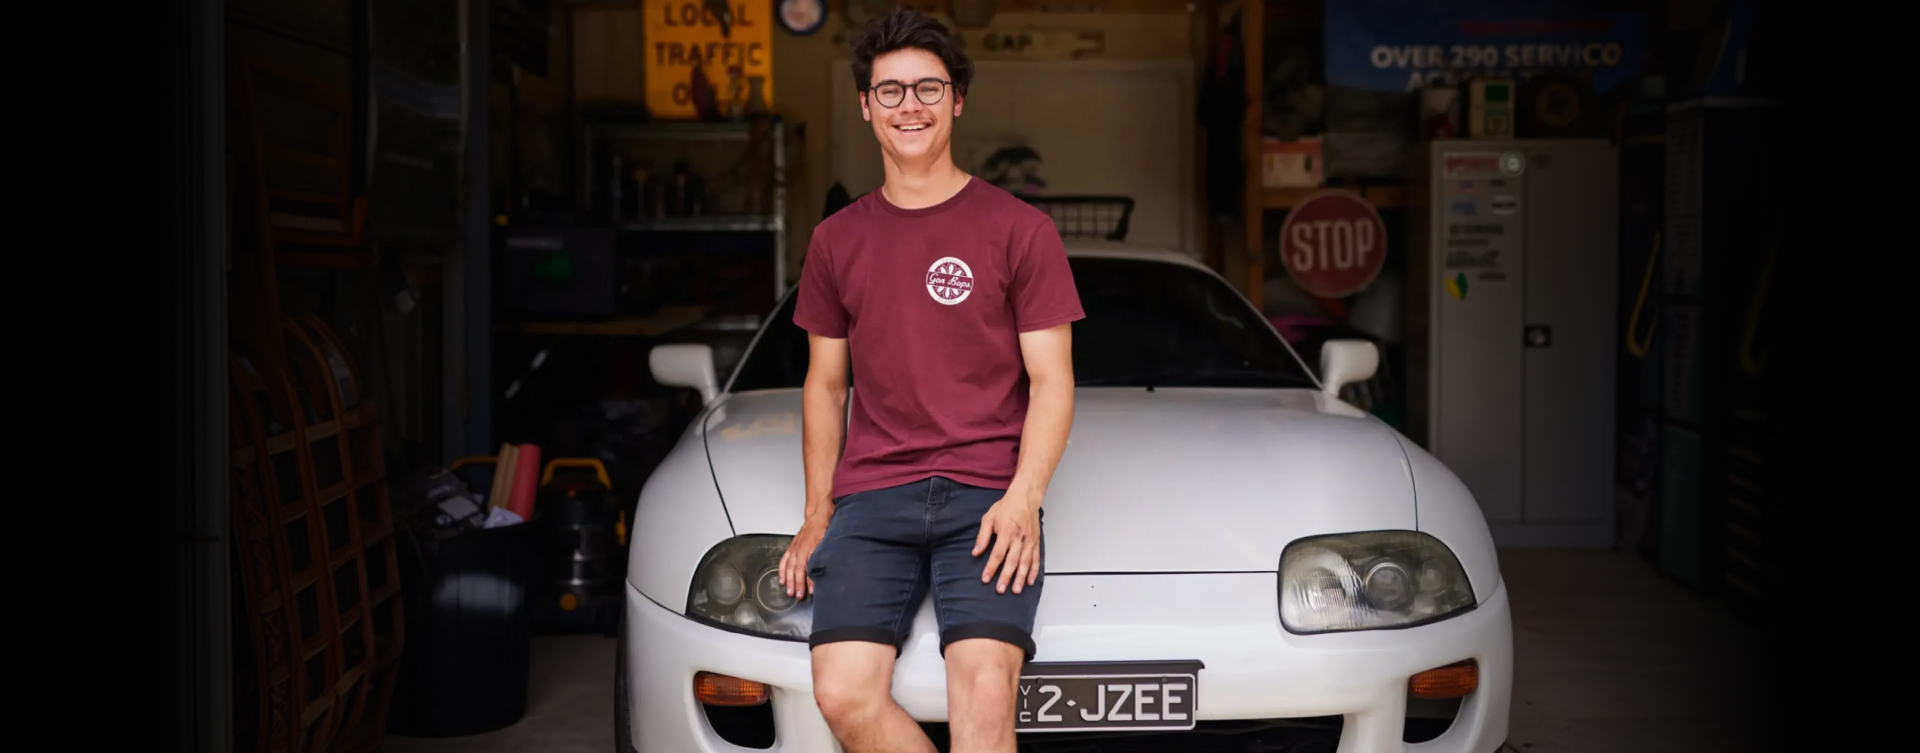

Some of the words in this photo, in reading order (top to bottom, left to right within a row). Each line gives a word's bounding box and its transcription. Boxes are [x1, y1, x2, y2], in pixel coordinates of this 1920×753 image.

[664, 4, 753, 27] LOCL
[655, 41, 763, 66] TRAFFIC
[1370, 44, 1444, 69] OVER
[1450, 44, 1499, 68] 290
[1291, 217, 1375, 271] STOP
[929, 272, 945, 285] Gon
[947, 276, 970, 289] Bops
[1019, 685, 1032, 722] VIC
